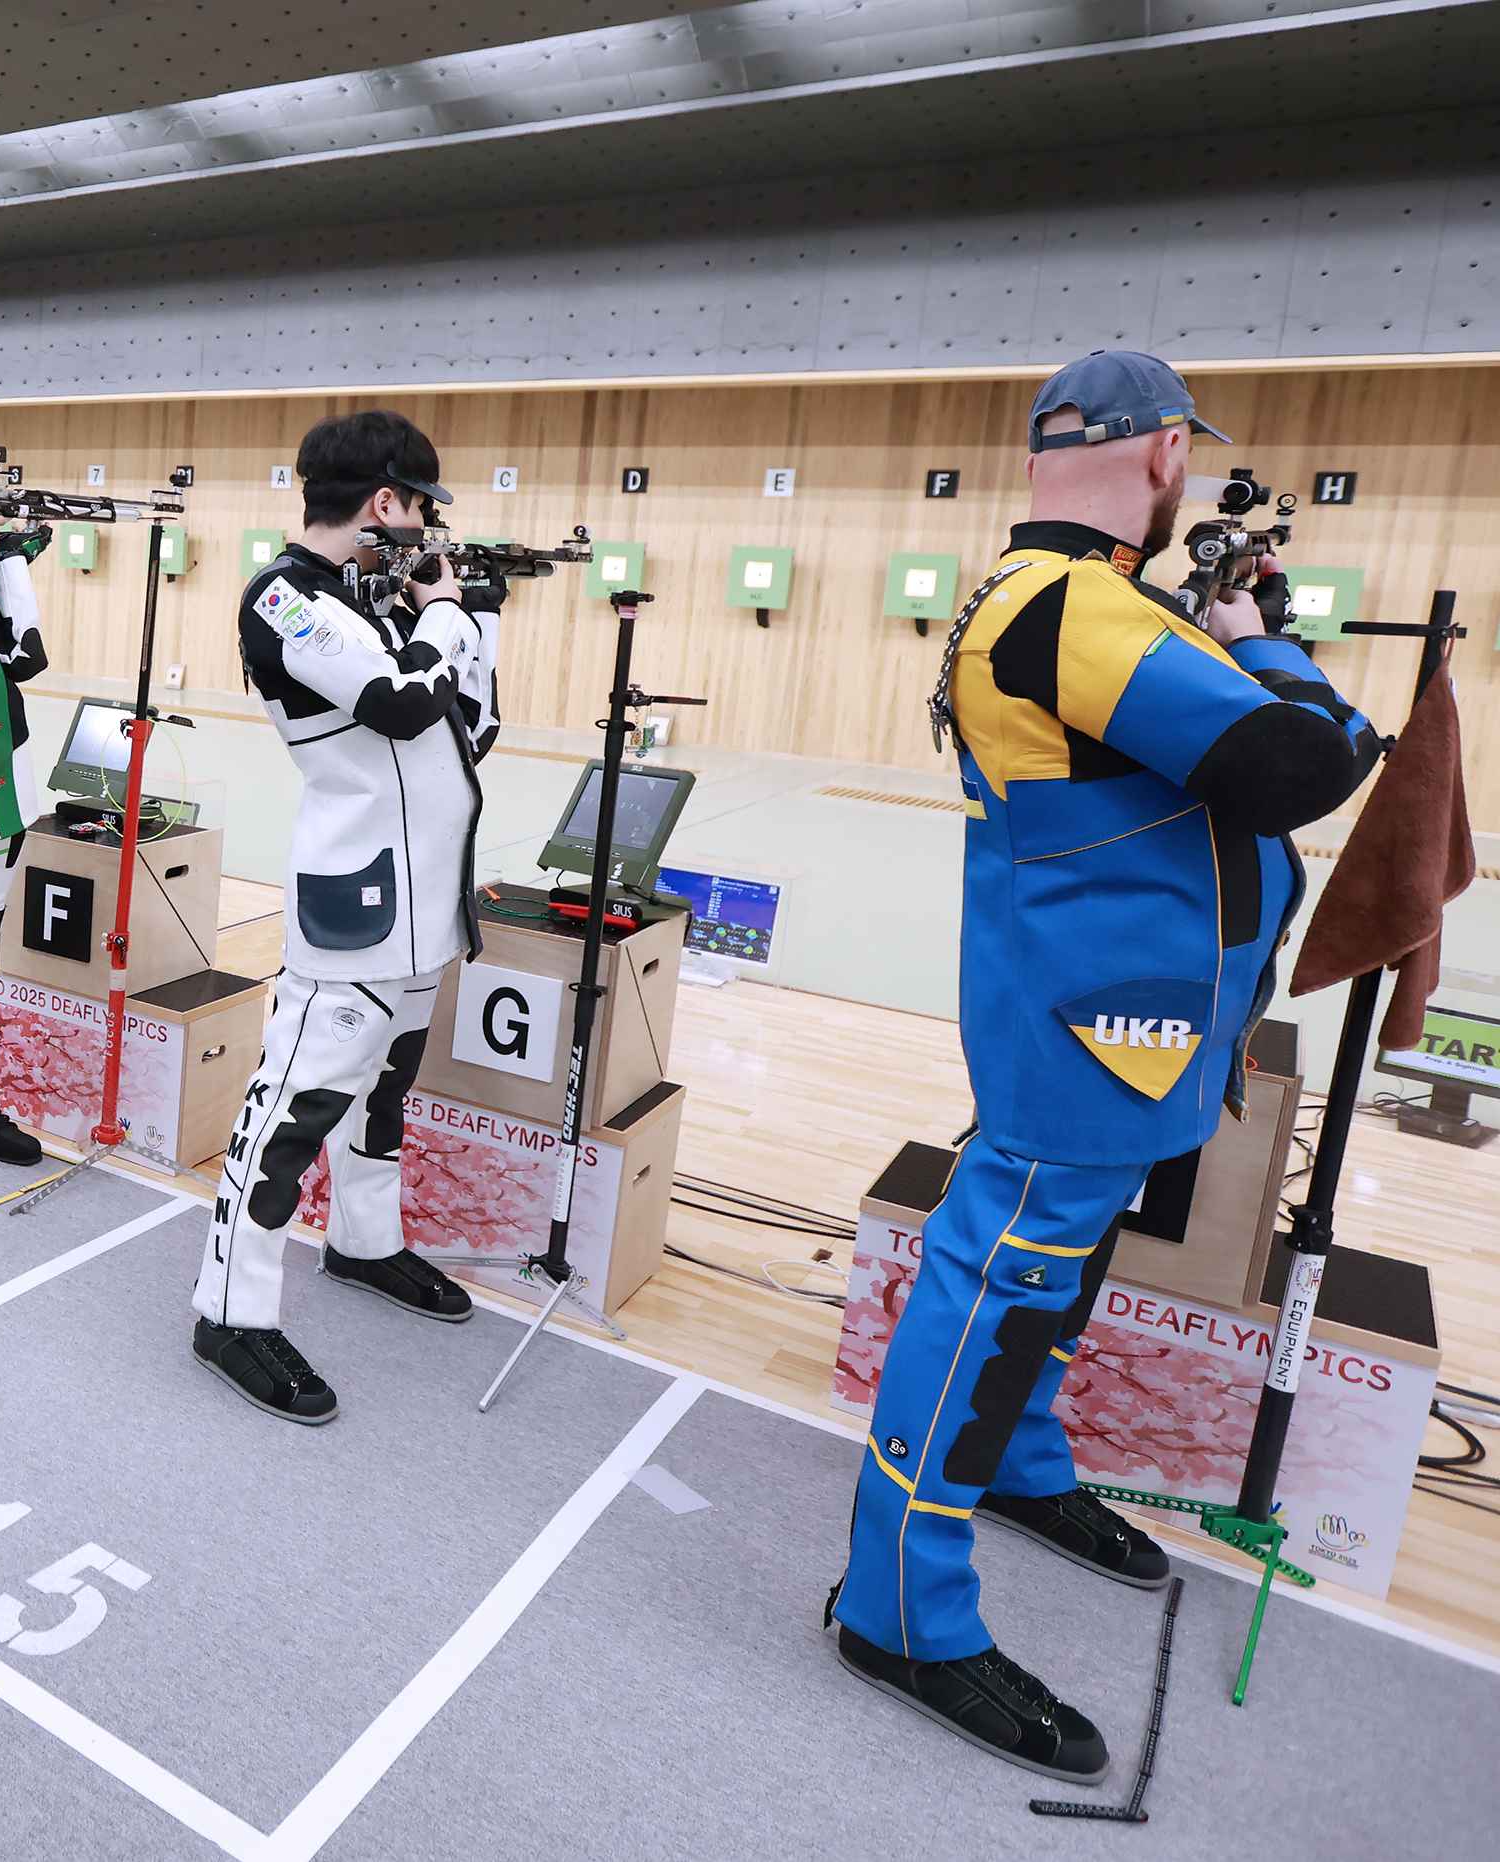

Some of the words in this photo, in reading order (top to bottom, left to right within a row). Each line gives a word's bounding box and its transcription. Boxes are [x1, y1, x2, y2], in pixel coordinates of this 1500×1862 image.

[93, 469, 100, 481] 7
[277, 470, 286, 485] A
[500, 470, 511, 487] C
[627, 471, 642, 491] D
[774, 472, 786, 491] E
[933, 473, 950, 495] F
[1320, 476, 1346, 501] H
[102, 813, 116, 824] SIUS
[44, 883, 71, 941] F
[612, 903, 633, 919] SIUS
[10, 984, 46, 1008] 2025
[51, 996, 167, 1042] DEAFLYPICS
[482, 986, 531, 1060] G
[1093, 1014, 1192, 1050] UKR
[1422, 1033, 1500, 1066] TAR
[227, 1079, 270, 1162] KIM
[431, 1103, 598, 1167] DEAFLYMPS
[1274, 1299, 1307, 1387] EQUIPMENT
